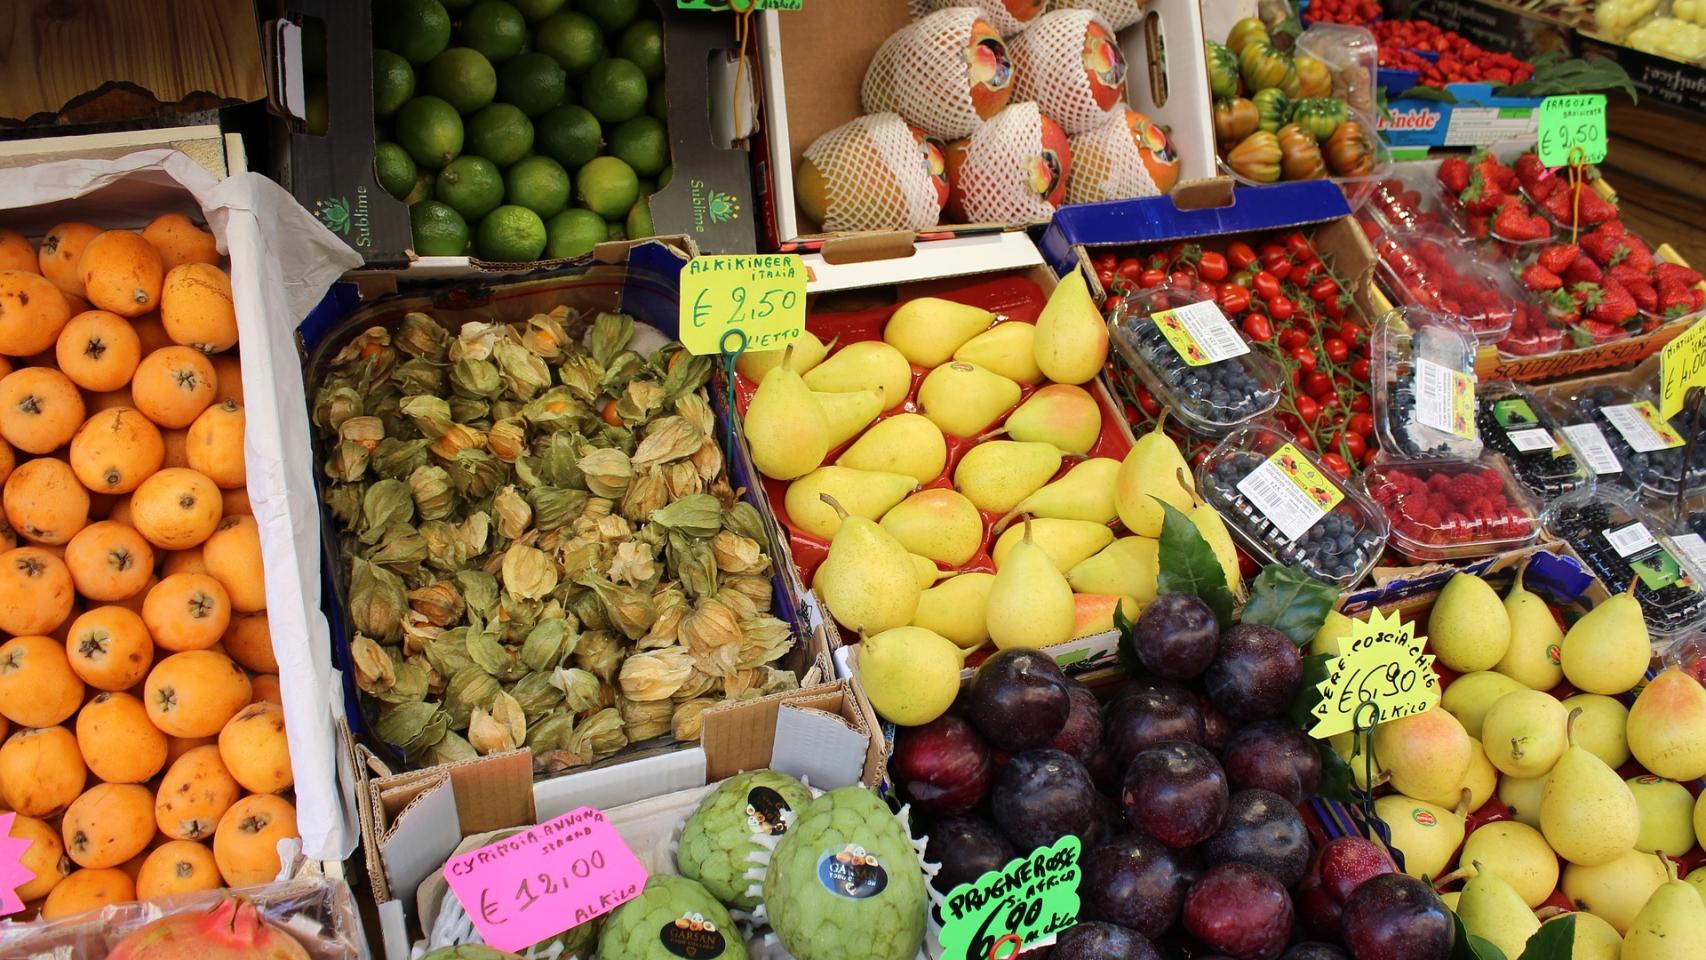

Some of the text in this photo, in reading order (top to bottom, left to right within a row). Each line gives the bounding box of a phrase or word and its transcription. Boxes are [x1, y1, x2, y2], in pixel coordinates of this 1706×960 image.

[1559, 125, 1599, 149] 2,50
[354, 186, 372, 248] Sublime
[691, 179, 706, 233] Sublime
[693, 286, 797, 328] € 2,50
[1494, 341, 1646, 379] SOUTHERN SUN
[481, 850, 606, 925] € 12,00
[670, 928, 717, 945] GARSAN
